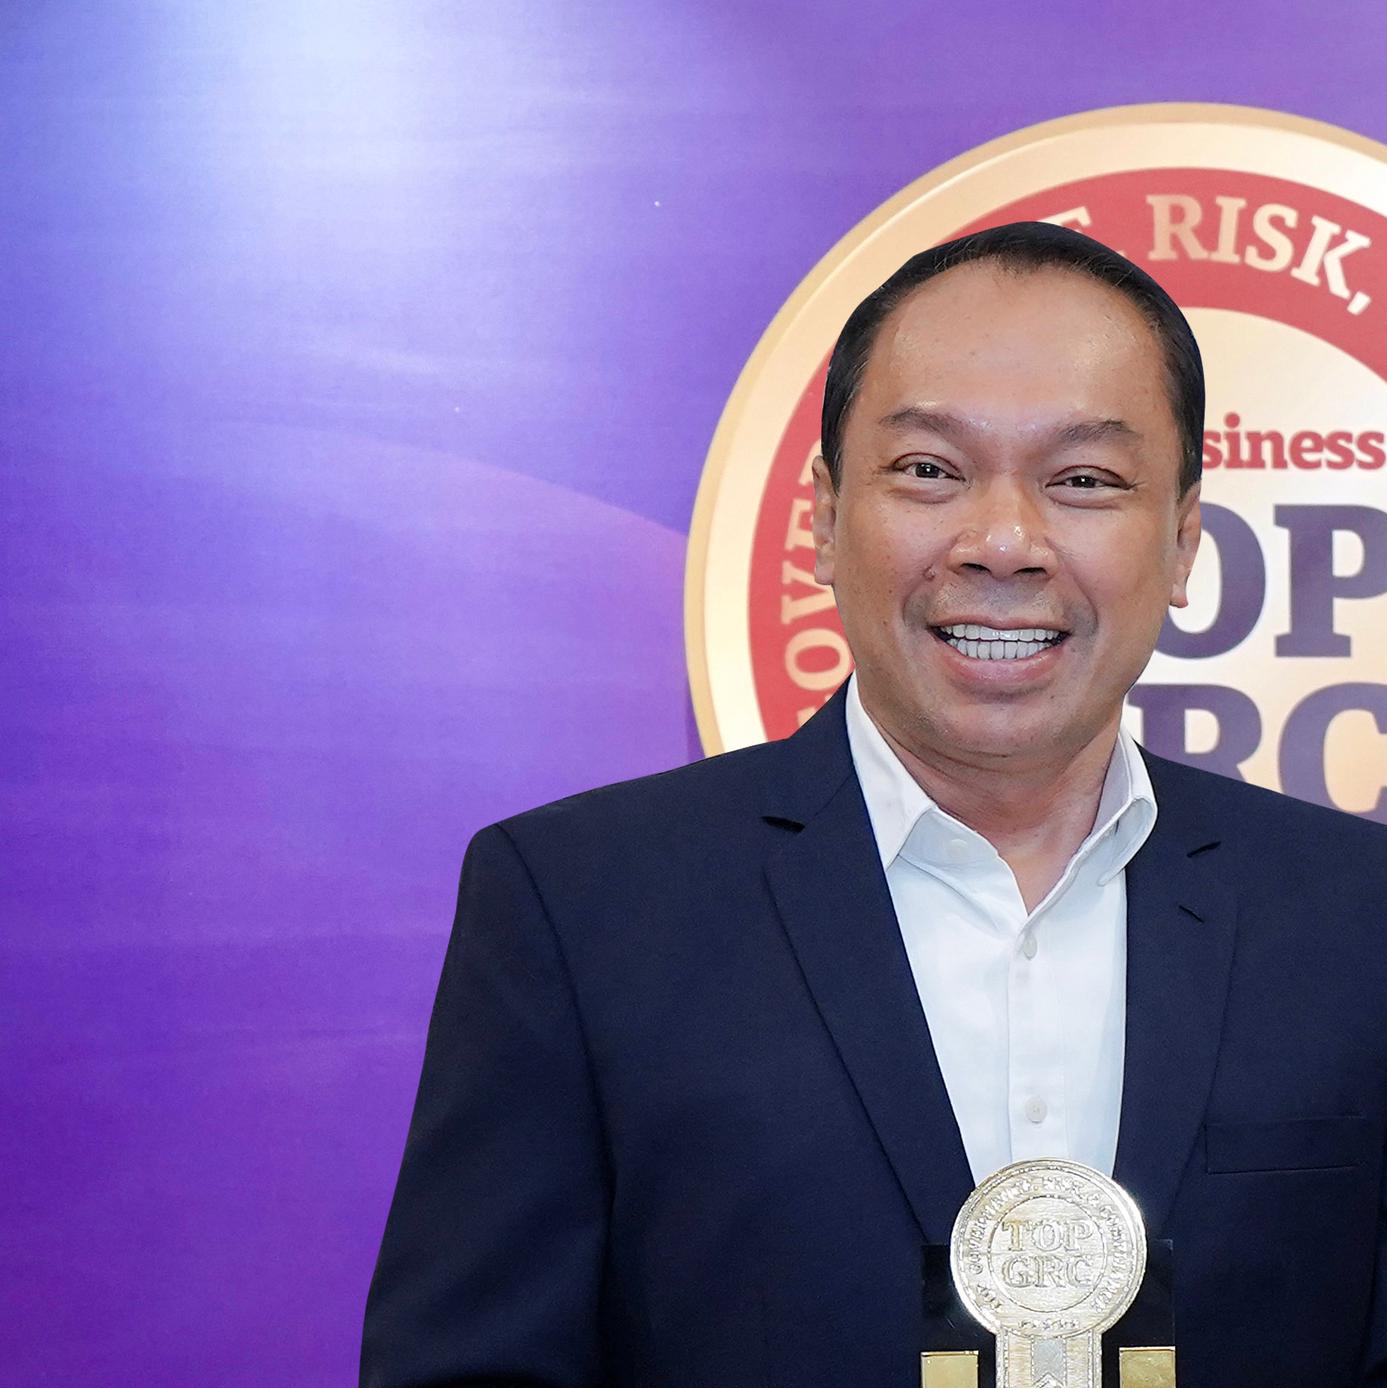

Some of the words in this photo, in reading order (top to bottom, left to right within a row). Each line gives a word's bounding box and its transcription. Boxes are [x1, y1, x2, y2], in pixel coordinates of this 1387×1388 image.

[1146, 194, 1371, 315] RISK,
[1203, 411, 1387, 471] siness
[1002, 1219, 1093, 1252] TOP
[1002, 1255, 1093, 1289] GRC
